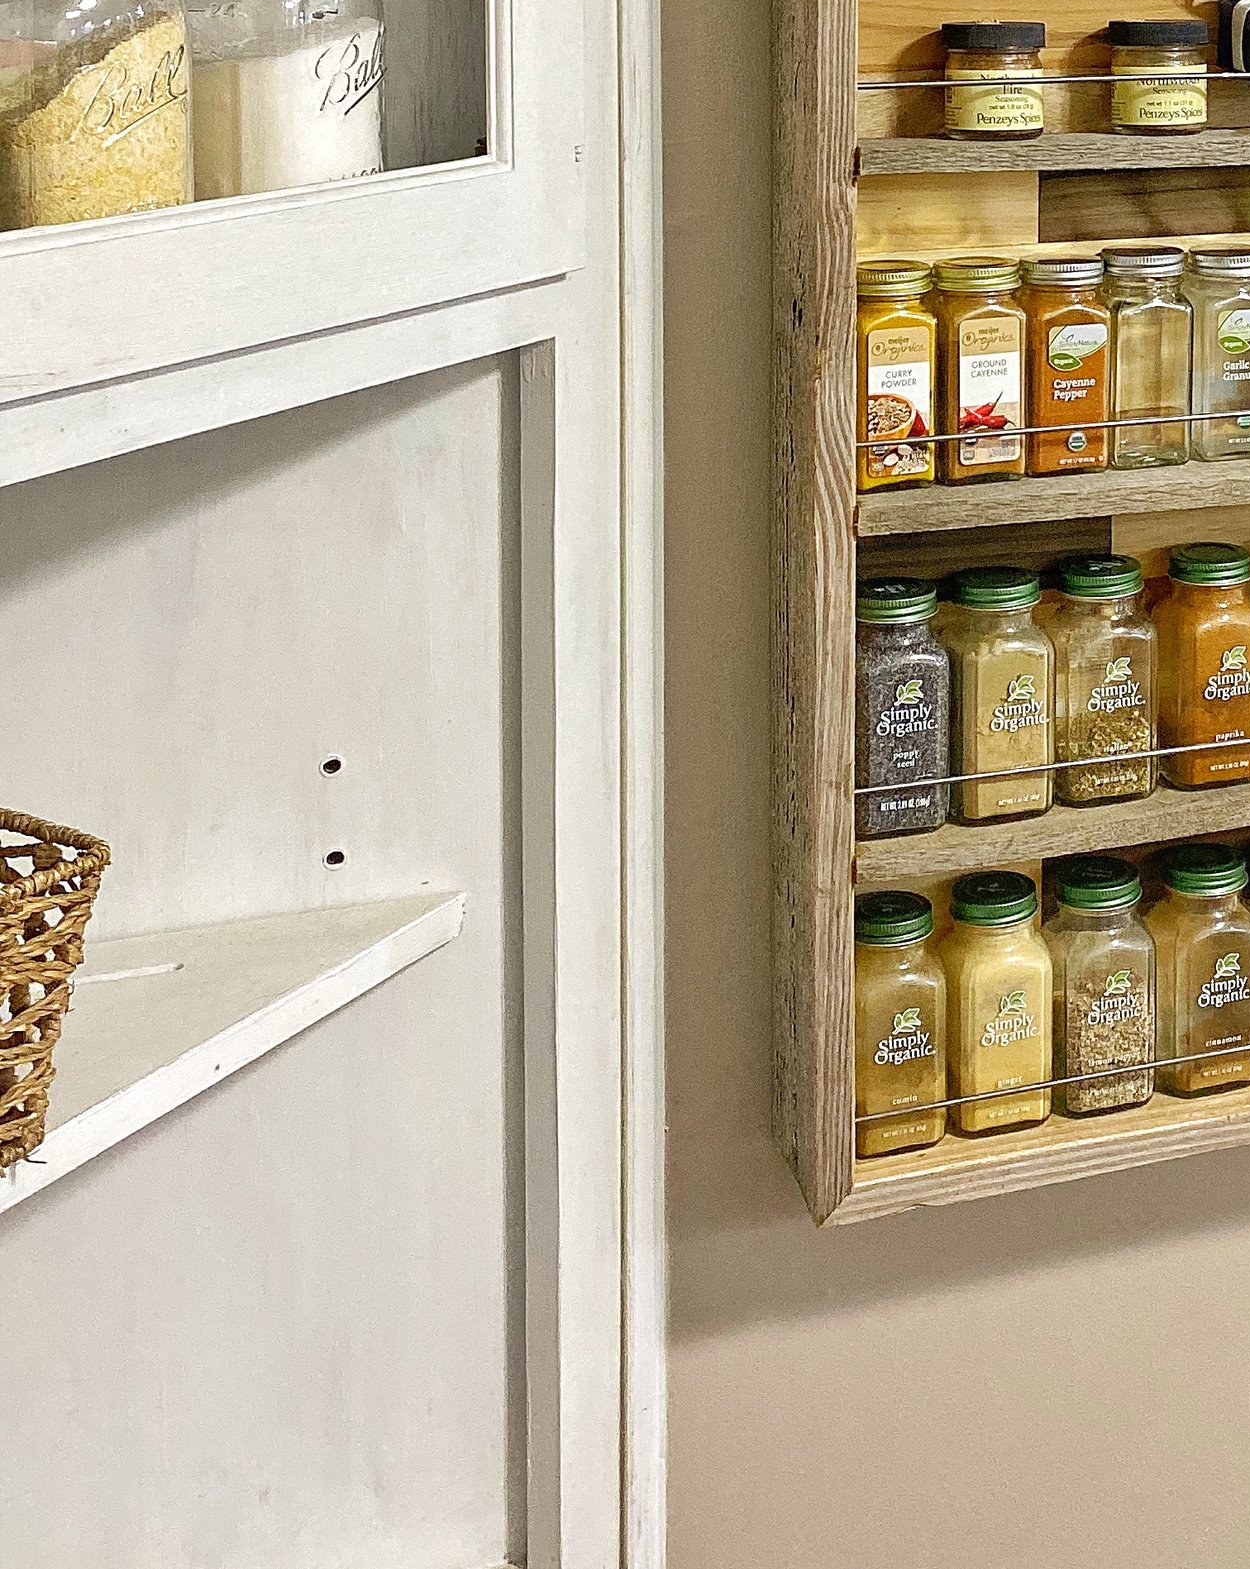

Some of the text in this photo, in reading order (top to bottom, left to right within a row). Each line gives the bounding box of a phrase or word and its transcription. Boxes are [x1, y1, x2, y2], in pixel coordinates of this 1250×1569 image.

[70, 44, 188, 142] Ball
[977, 112, 1040, 127] Penzeys Spices
[1140, 107, 1203, 121] Penzeys Spices
[962, 332, 1014, 351] Organics
[872, 340, 925, 360] Organics
[972, 359, 1007, 369] GROUND
[1223, 360, 1250, 371] Garlic
[886, 369, 912, 379] CURRY
[970, 368, 1008, 378] CAYENNE
[881, 378, 917, 388] POWDER
[1053, 377, 1096, 391] Cayenne
[1053, 389, 1088, 402] Pepper
[1091, 680, 1140, 700] Simply
[880, 702, 932, 724] Simply
[994, 698, 1044, 719] Simply
[1215, 729, 1244, 742] paprika
[893, 749, 920, 761] poppy
[896, 758, 915, 768] seed
[1202, 975, 1247, 996] Simply
[1091, 992, 1137, 1012] Simply
[985, 1013, 1034, 1033] Simply
[878, 1031, 929, 1051] Simply
[1205, 1035, 1242, 1047] cinnamon
[997, 1075, 1023, 1089] ginger
[892, 1094, 918, 1105] cumin
